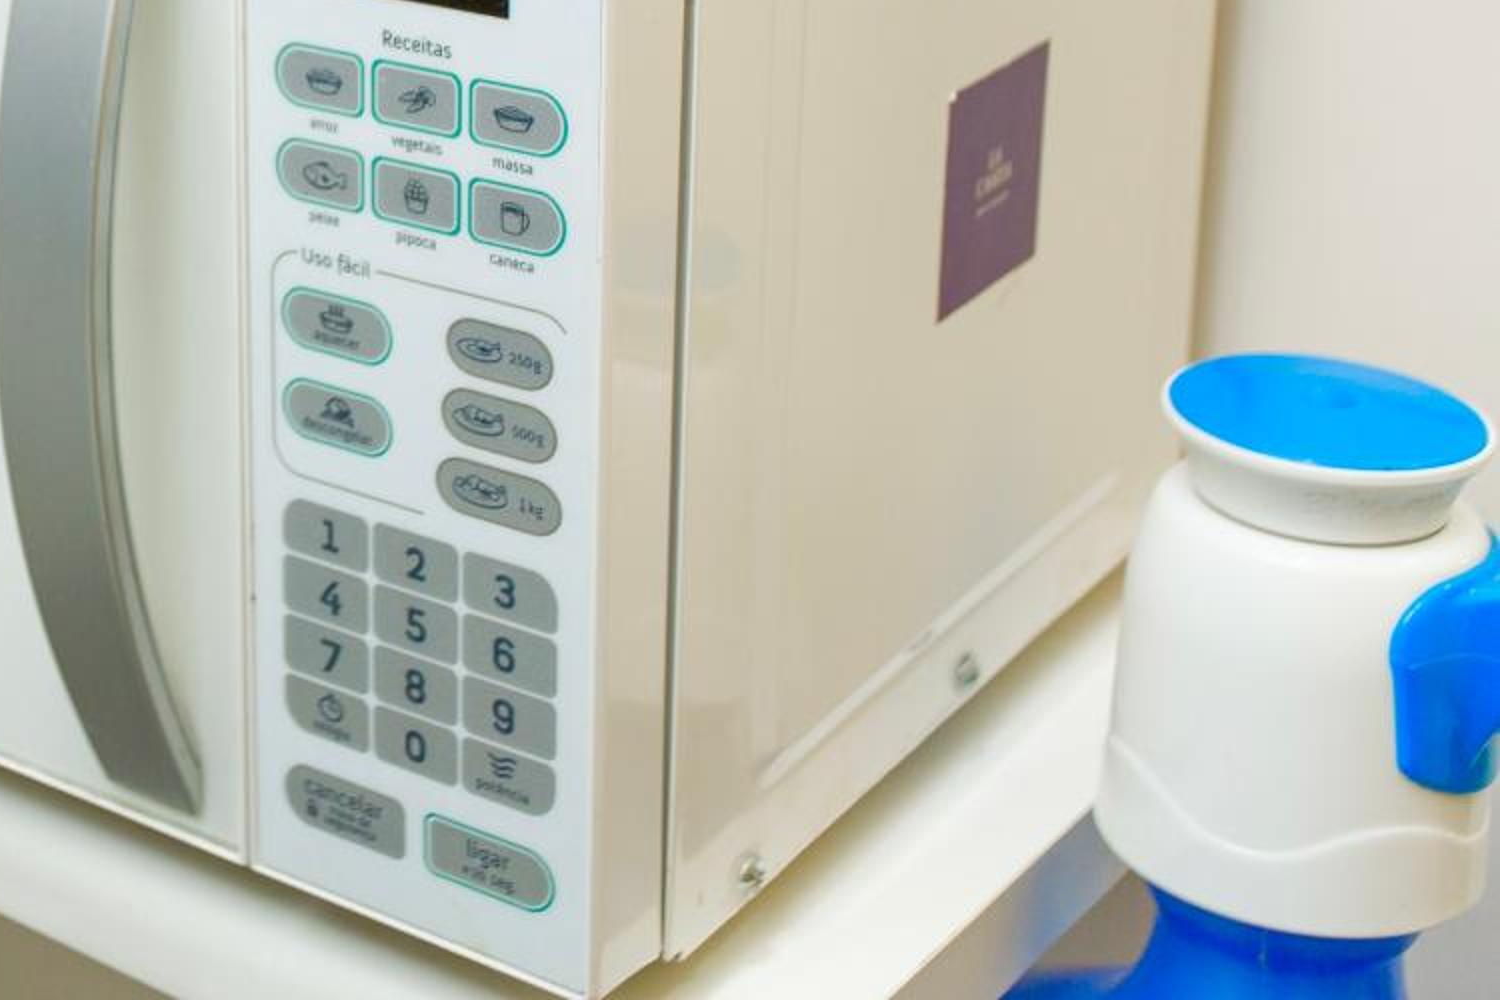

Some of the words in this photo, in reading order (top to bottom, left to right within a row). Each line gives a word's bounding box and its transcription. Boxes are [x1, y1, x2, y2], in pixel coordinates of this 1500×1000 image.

[381, 30, 453, 59] Receitas
[391, 136, 444, 156] vegetais
[492, 156, 534, 175] massa
[395, 230, 437, 251] pipoca
[300, 247, 333, 269] Uso
[336, 252, 371, 279] fácil
[489, 254, 535, 274] caneca
[321, 519, 339, 553] 1
[405, 547, 426, 582] 2
[320, 581, 342, 616] 4
[494, 575, 516, 609] 3
[405, 608, 427, 643] 5
[320, 639, 342, 672] 7
[492, 637, 516, 672] 6
[405, 669, 427, 704] 8
[492, 699, 516, 735] 9
[405, 730, 427, 764] 0
